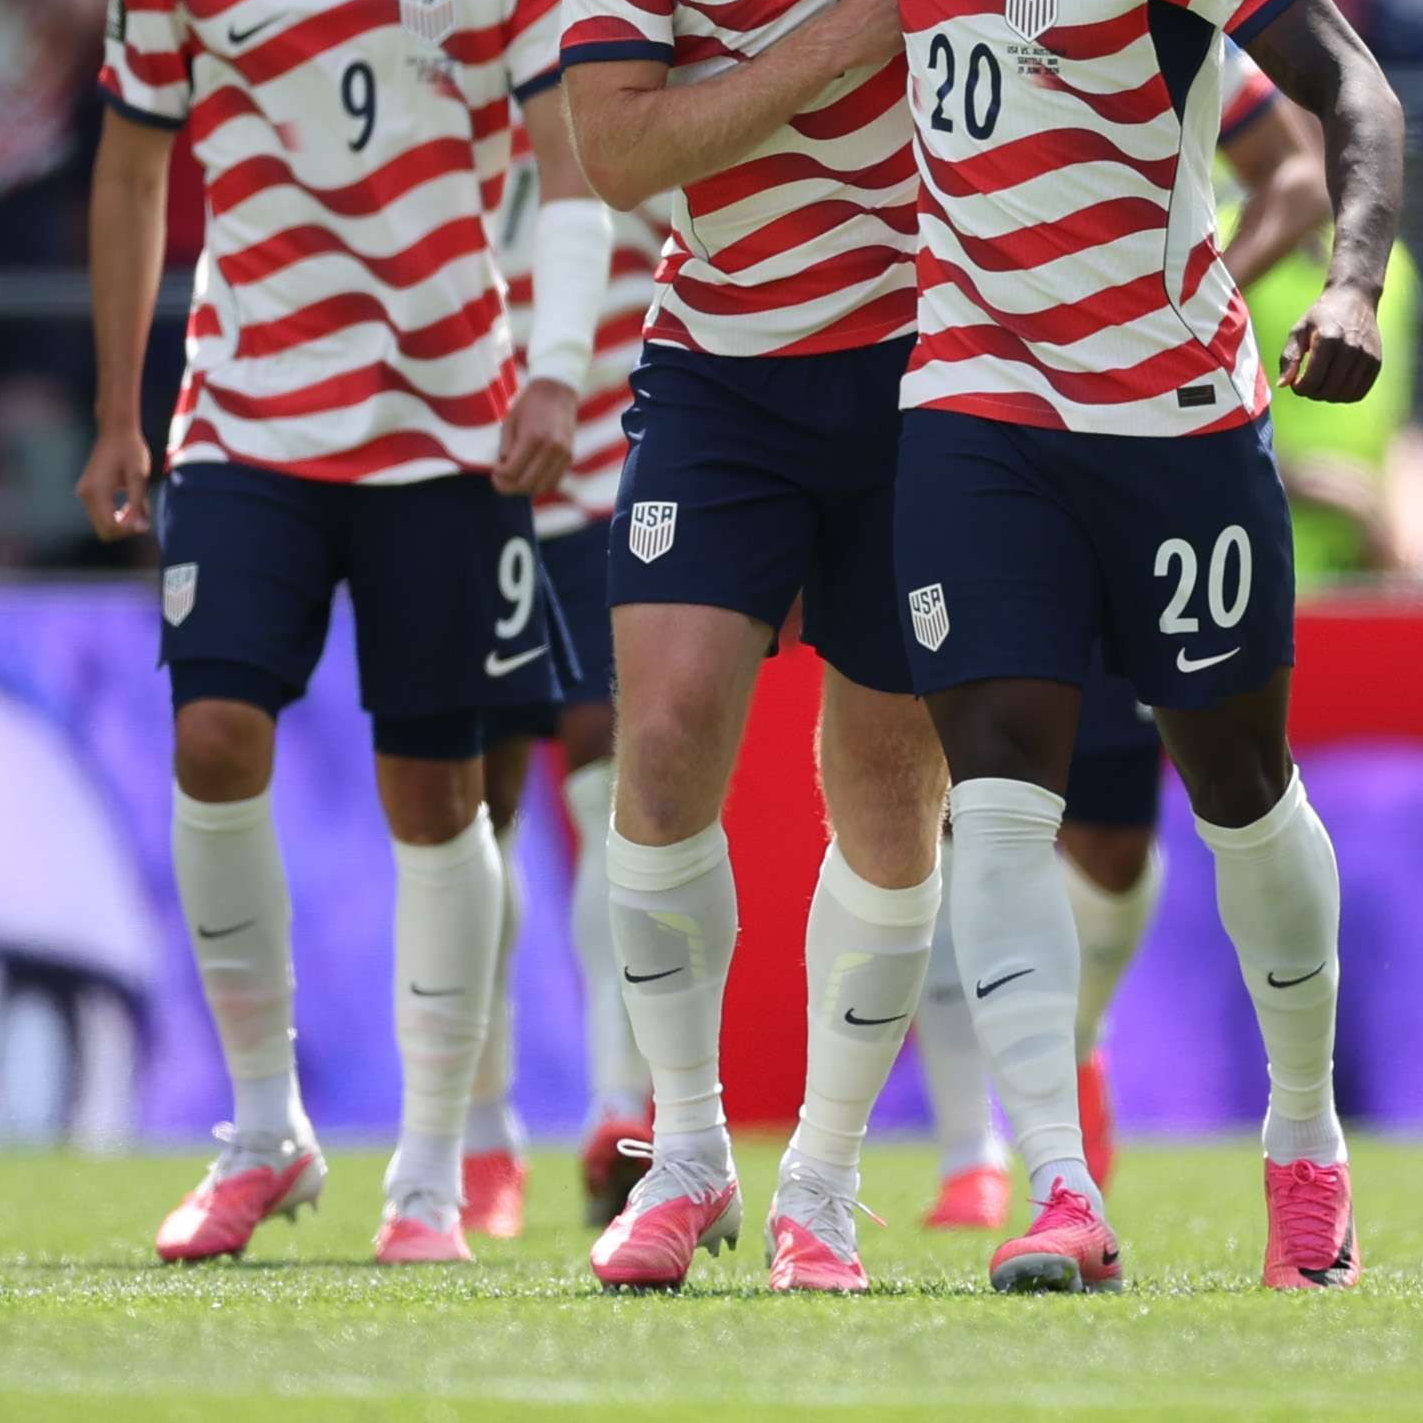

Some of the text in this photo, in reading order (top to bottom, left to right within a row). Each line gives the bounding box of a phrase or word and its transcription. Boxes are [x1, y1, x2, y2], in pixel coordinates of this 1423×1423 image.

[341, 62, 376, 152] 9
[928, 33, 1002, 141] 20
[634, 505, 674, 528] USA
[495, 536, 535, 639] 9
[911, 587, 941, 615] USA
[1153, 525, 1252, 635] 20
